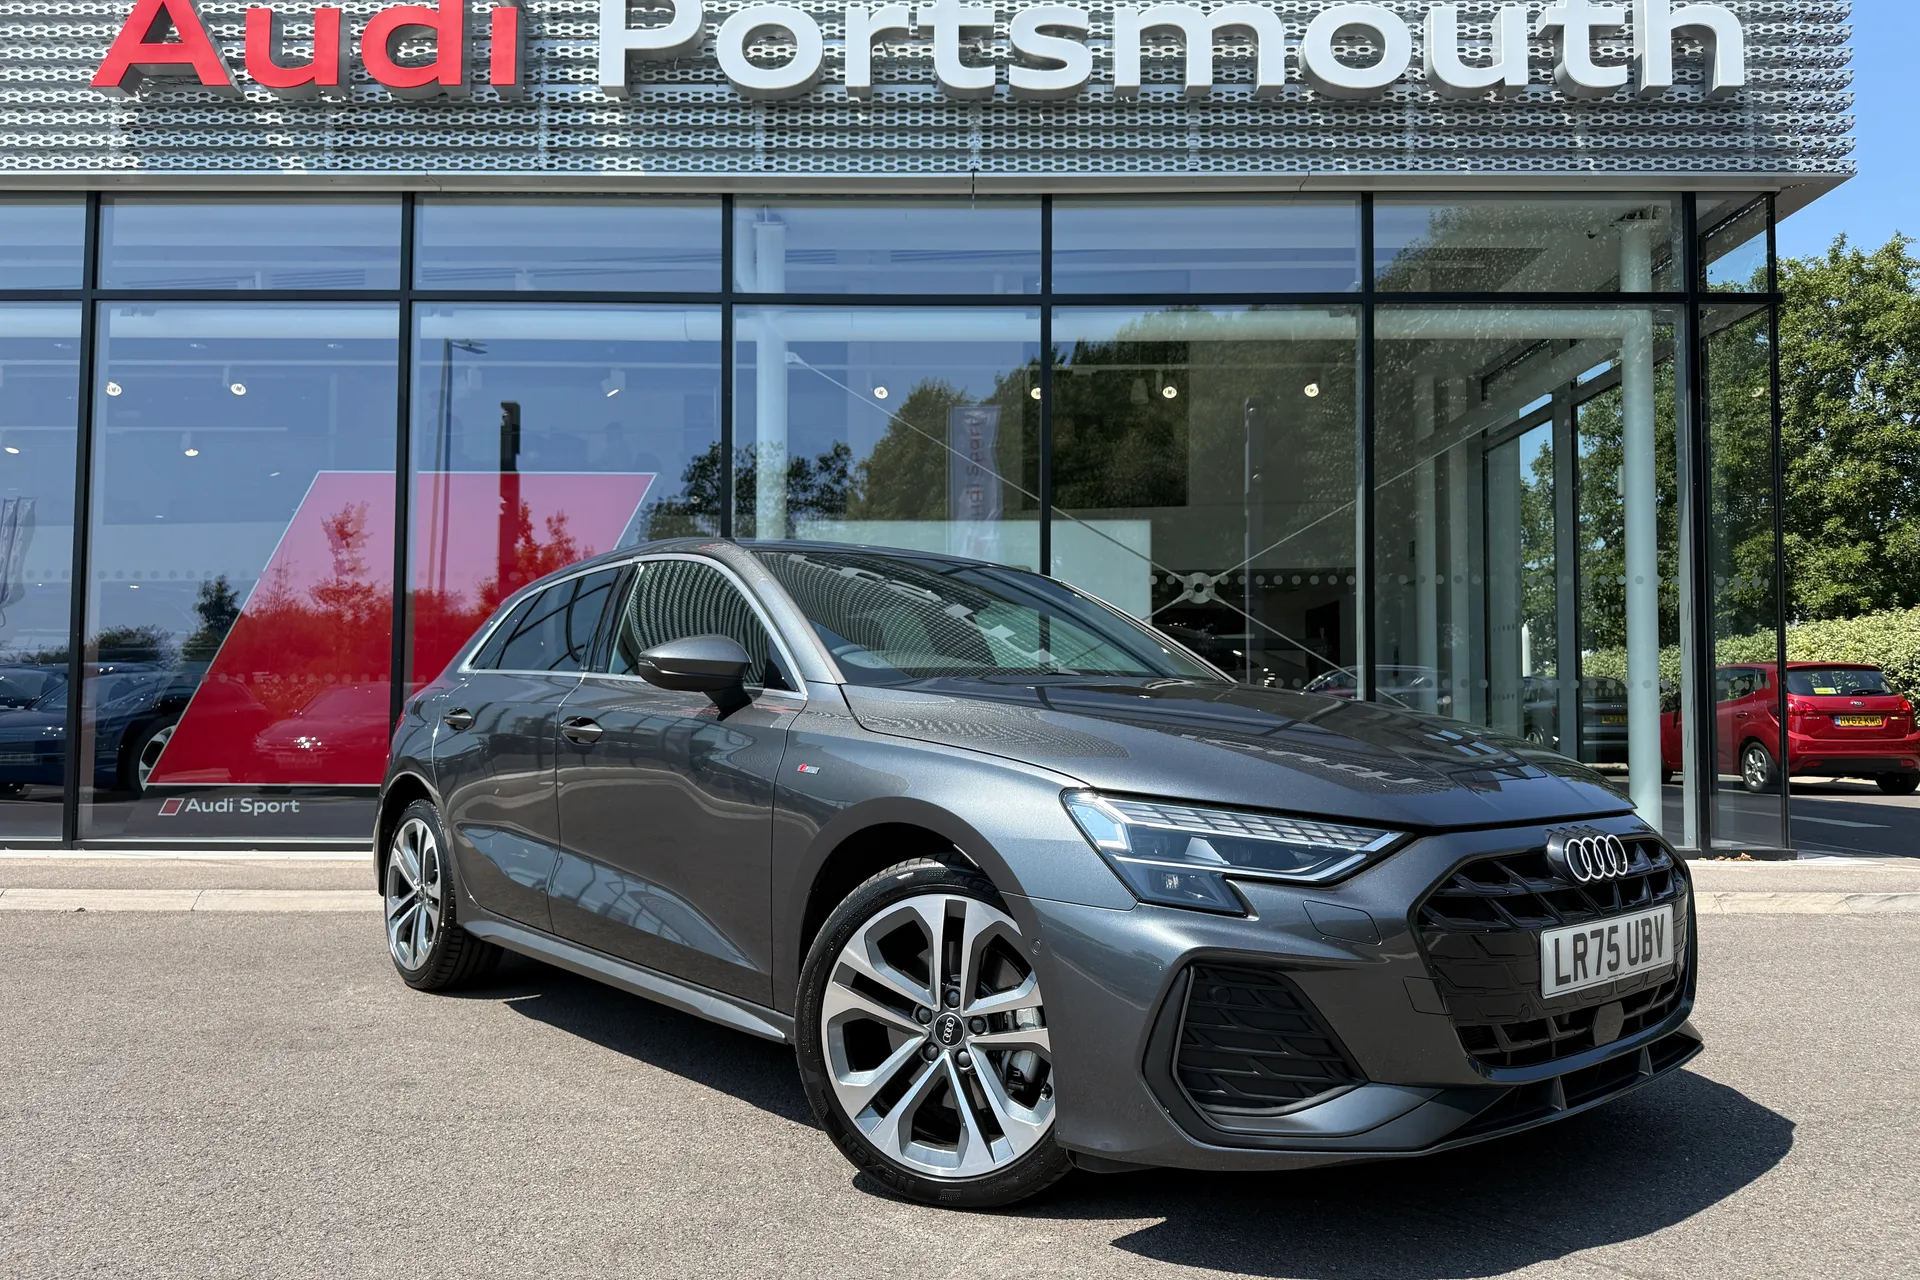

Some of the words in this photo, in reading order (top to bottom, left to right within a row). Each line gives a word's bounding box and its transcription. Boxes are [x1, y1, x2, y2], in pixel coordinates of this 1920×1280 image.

[90, 0, 521, 91] Audi
[598, 0, 1746, 91] Portsmouth
[184, 797, 233, 813] Audi
[239, 797, 300, 817] Sport
[1554, 925, 1620, 987] LR75
[1626, 913, 1665, 967] UBV
[838, 1133, 917, 1194] NEXEN
